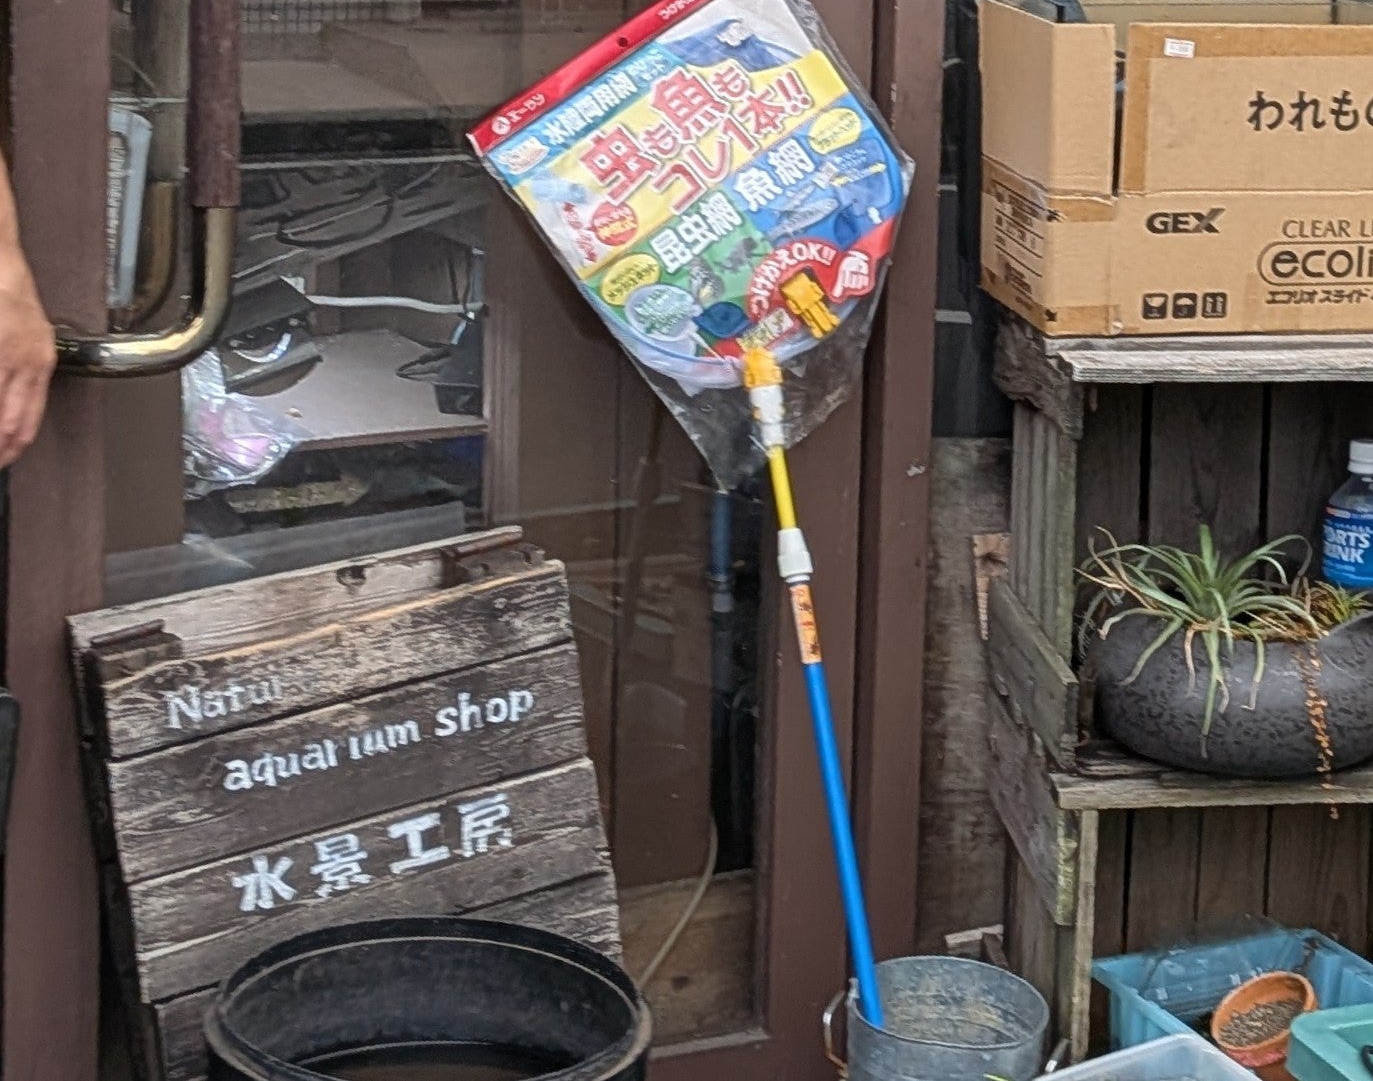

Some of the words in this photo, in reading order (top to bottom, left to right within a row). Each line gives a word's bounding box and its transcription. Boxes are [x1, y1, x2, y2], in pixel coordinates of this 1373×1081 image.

[578, 58, 753, 205] 虫も魚も
[651, 192, 743, 275] 昆虫網
[1145, 207, 1226, 235] GEX
[1281, 219, 1352, 239] CLEAR
[434, 690, 534, 737] shop
[230, 793, 516, 912] 水景工房
